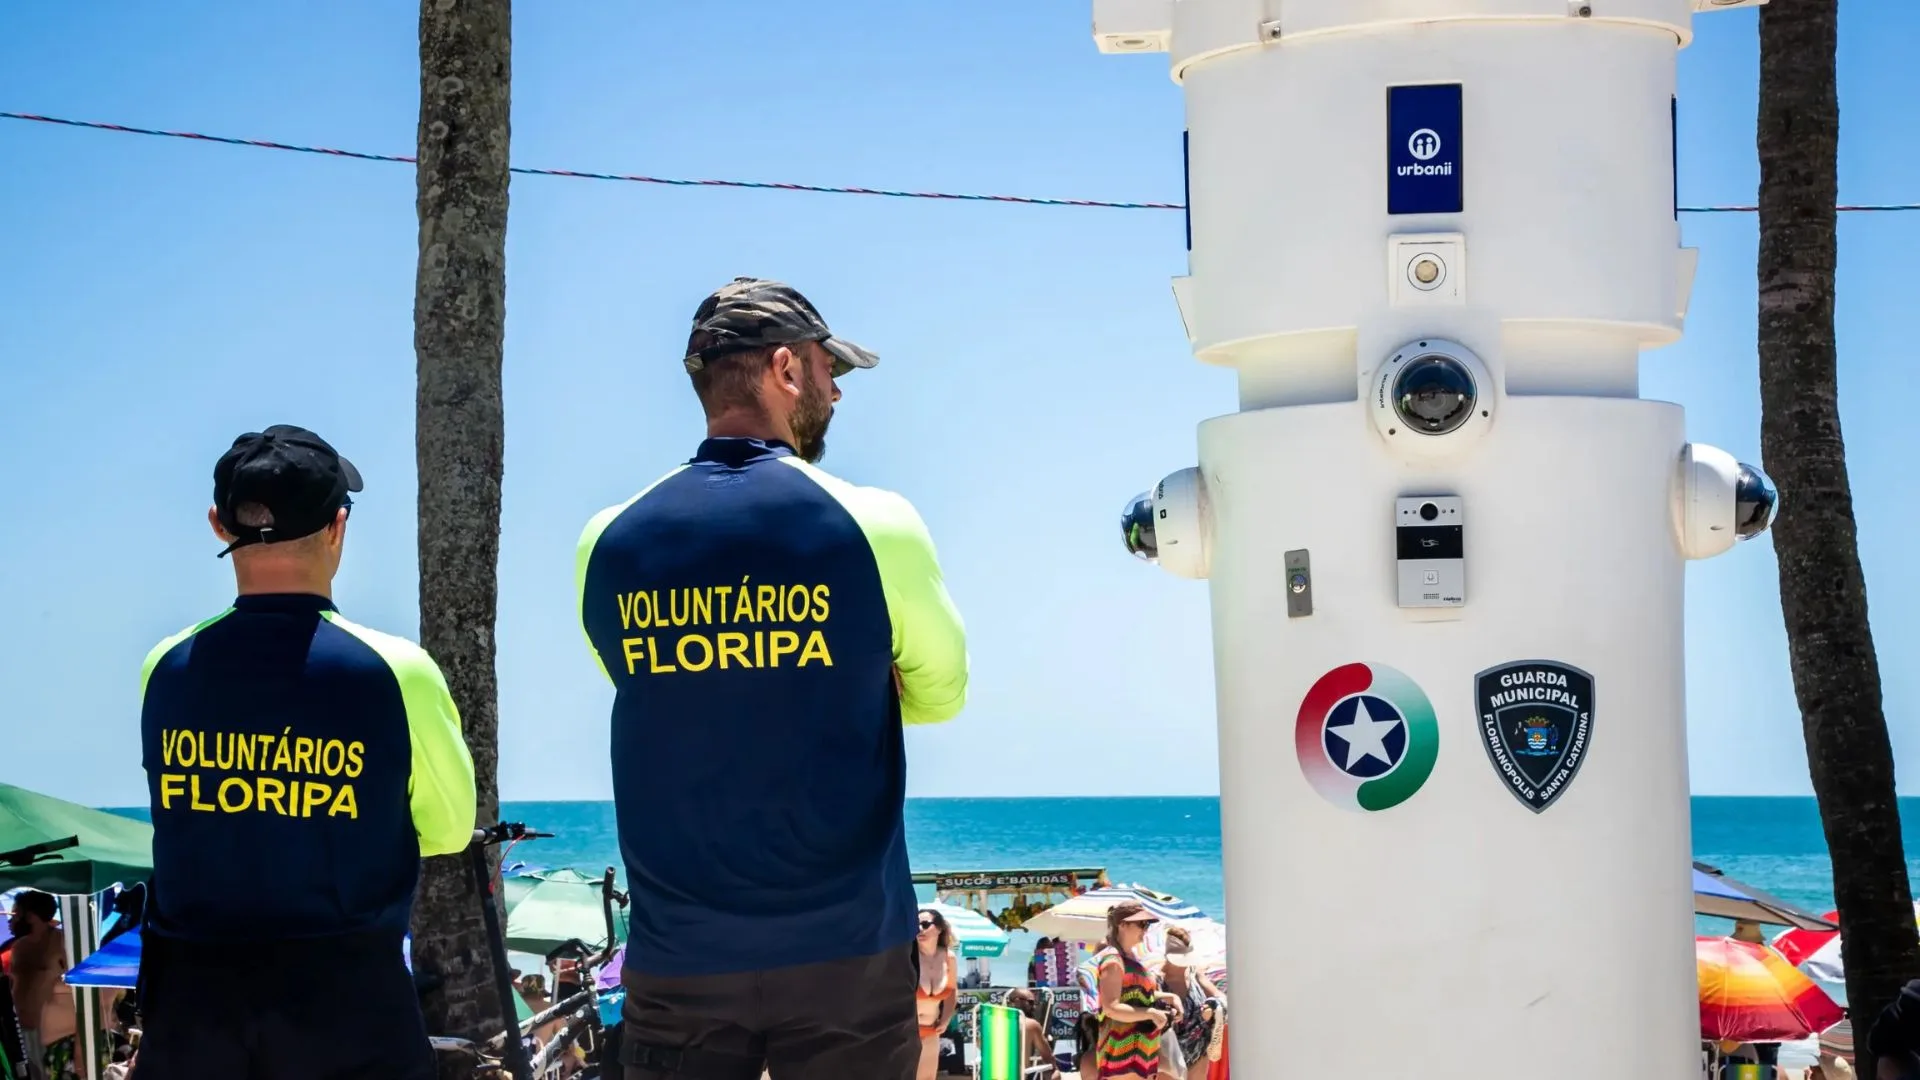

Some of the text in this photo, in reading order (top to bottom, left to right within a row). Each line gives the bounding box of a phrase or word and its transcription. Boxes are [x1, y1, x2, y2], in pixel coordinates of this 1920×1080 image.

[1397, 161, 1452, 176] urbanii
[617, 575, 830, 630] VOLUNTÁRIOS
[622, 630, 833, 674] FLORIPA
[1490, 687, 1579, 709] MUNICIPAL
[1500, 671, 1567, 687] GUARDA
[162, 726, 365, 778] VOLUNTÁRIOS
[1483, 713, 1535, 800] FLORIANÓPOLIS
[1540, 711, 1589, 800] SANTA CATARINA
[161, 773, 358, 819] FLORIPA
[945, 877, 992, 886] SUCOS
